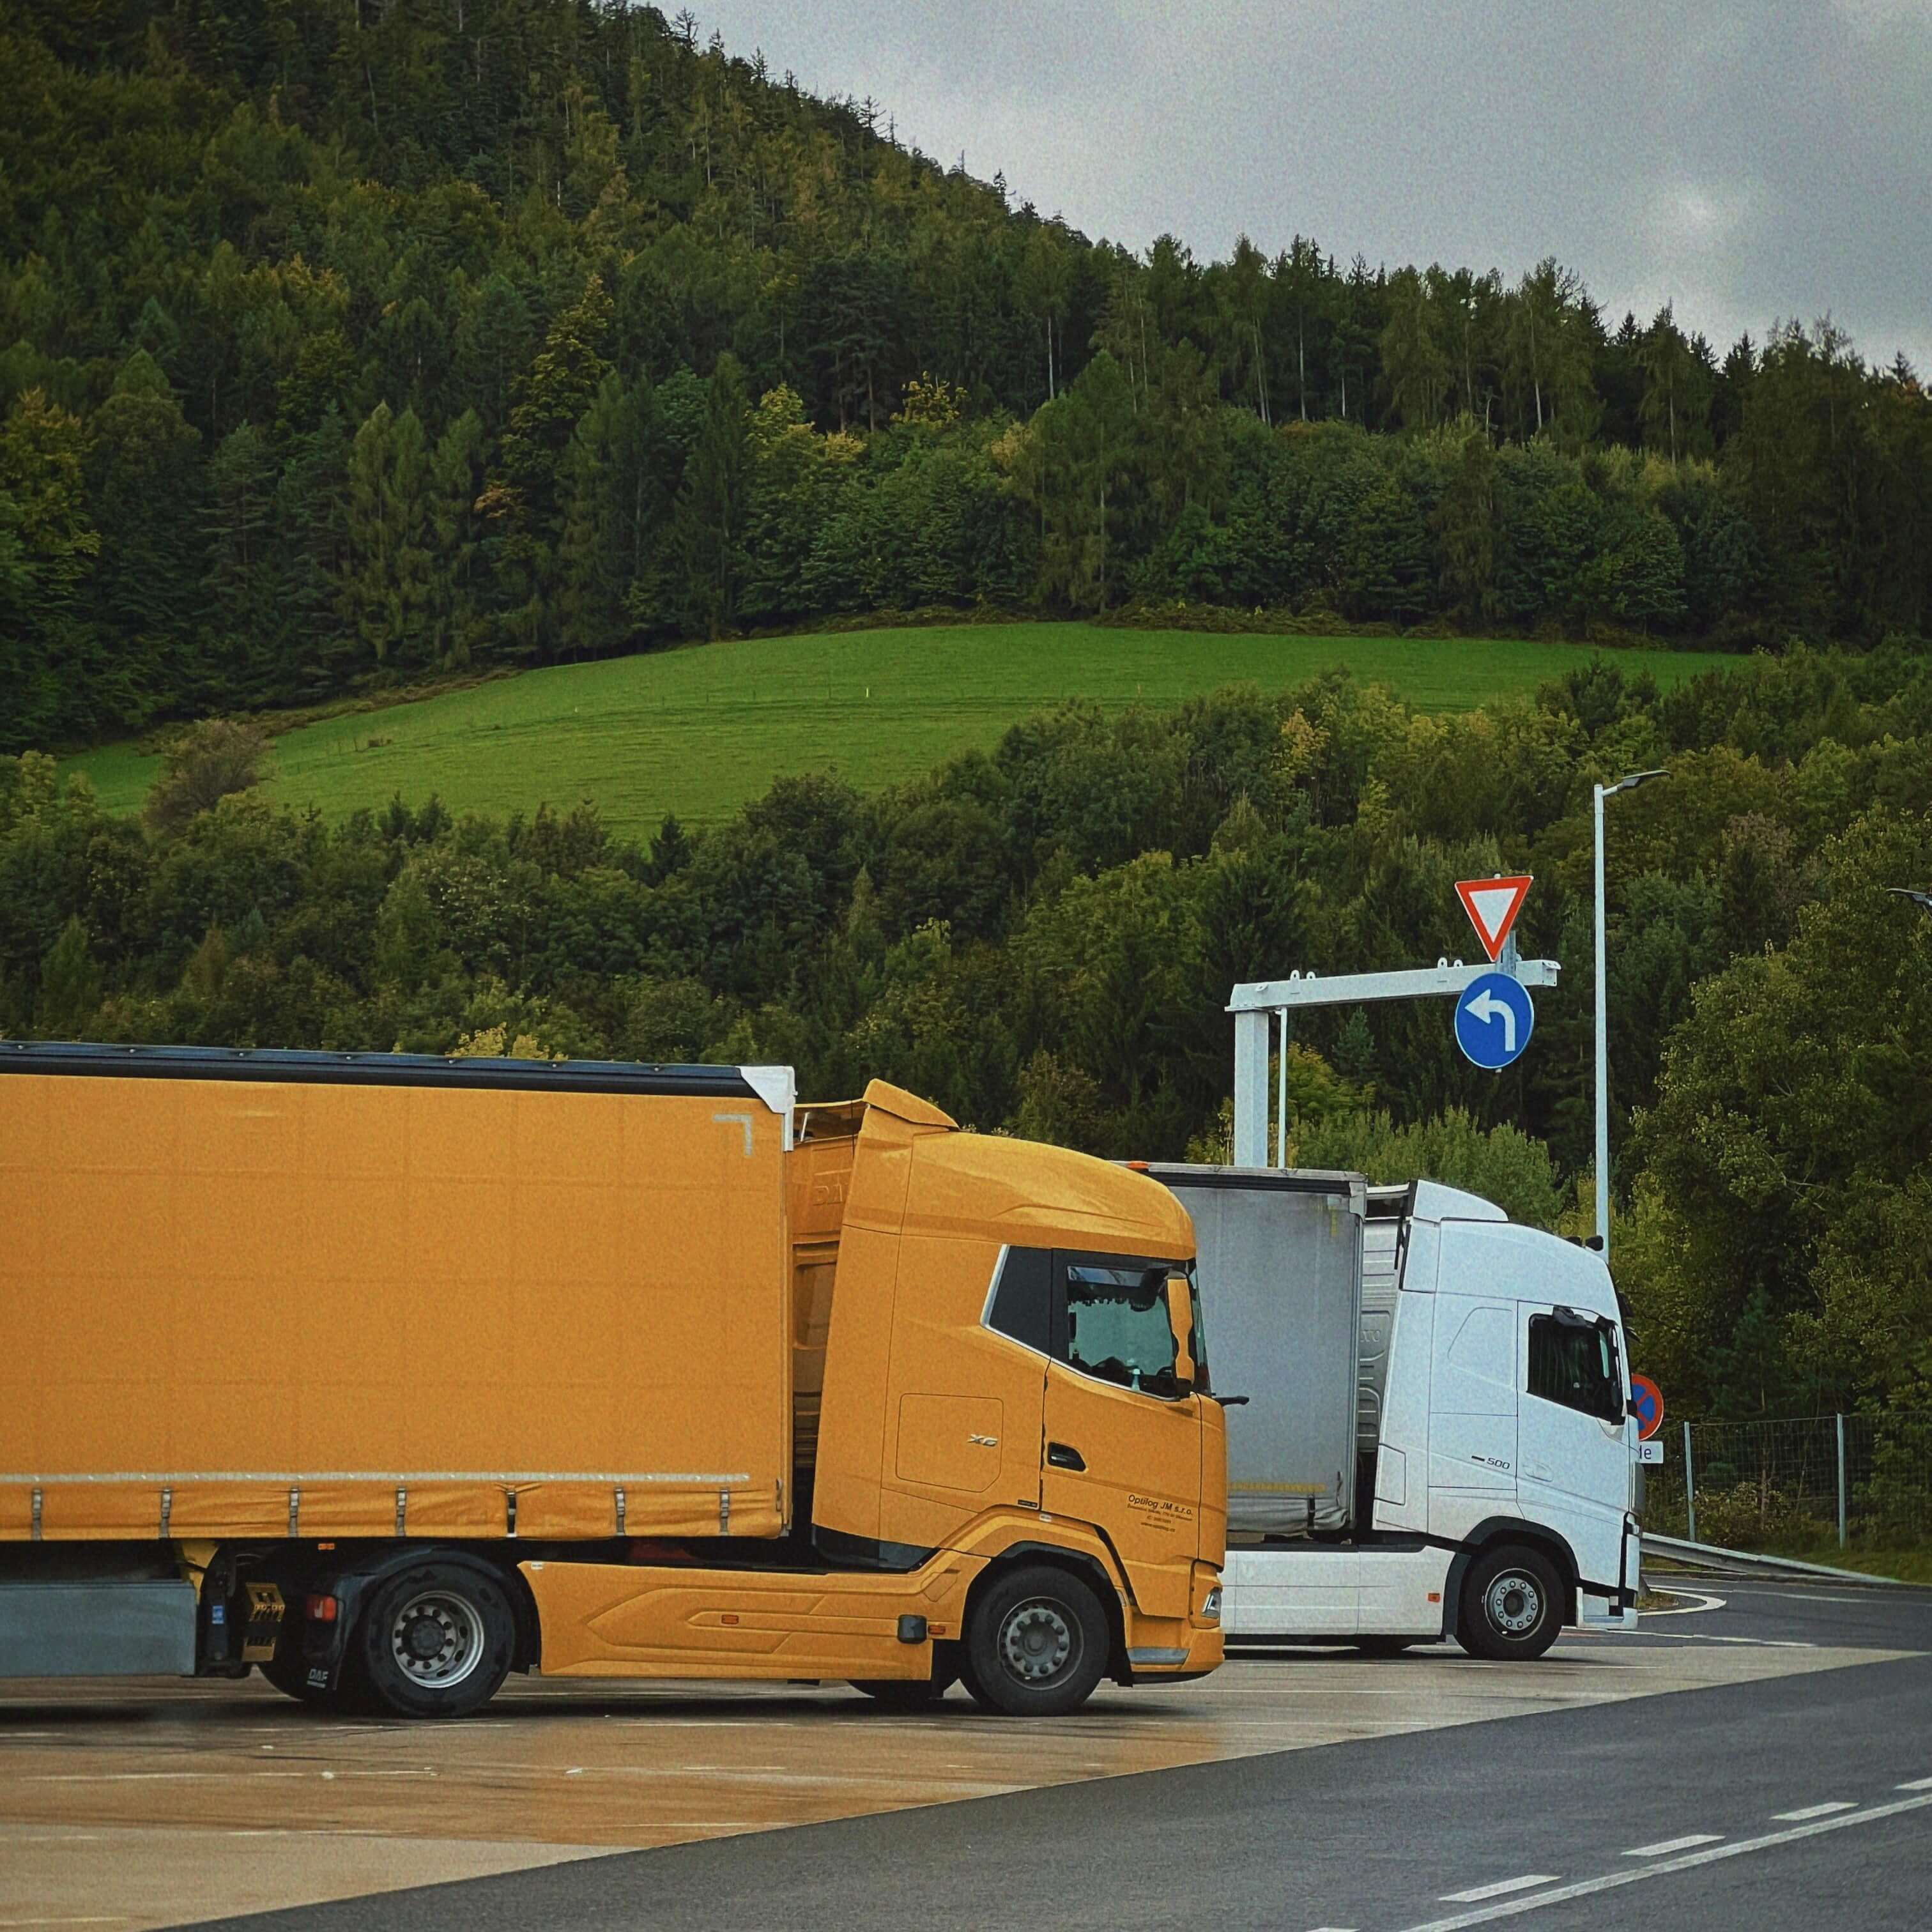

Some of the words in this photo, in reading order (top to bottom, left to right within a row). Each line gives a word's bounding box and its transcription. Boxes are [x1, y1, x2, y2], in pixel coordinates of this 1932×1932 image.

[967, 1434, 998, 1446] XG
[1487, 1457, 1510, 1469] 500
[1128, 1494, 1158, 1509] Optilog
[1160, 1502, 1173, 1510] JM
[309, 1668, 328, 1681] DAF
